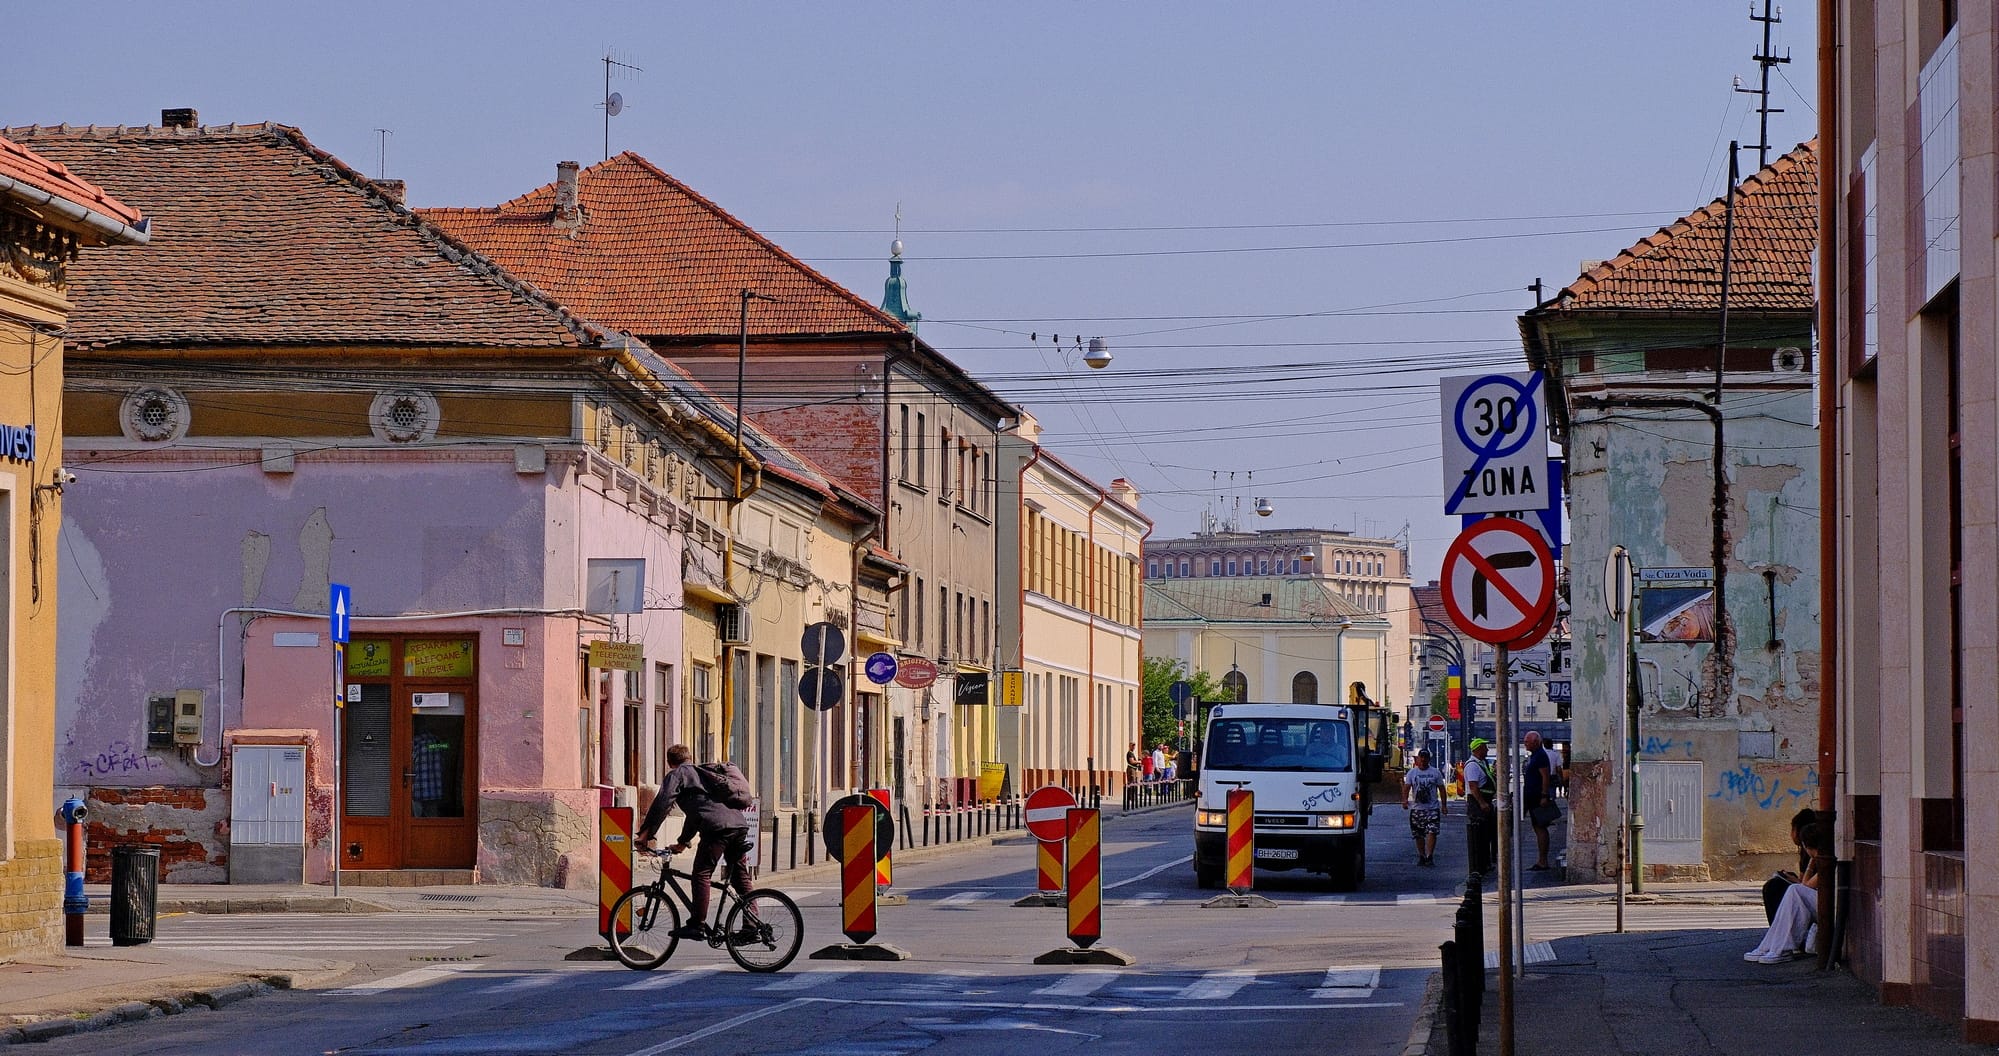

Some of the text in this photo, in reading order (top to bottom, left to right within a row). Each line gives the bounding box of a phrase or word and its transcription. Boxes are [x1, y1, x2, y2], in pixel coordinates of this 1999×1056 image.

[1474, 396, 1518, 436] 30
[1463, 466, 1535, 498] ZONA
[1656, 570, 1681, 579] Cuza
[1683, 569, 1708, 578] Vodă
